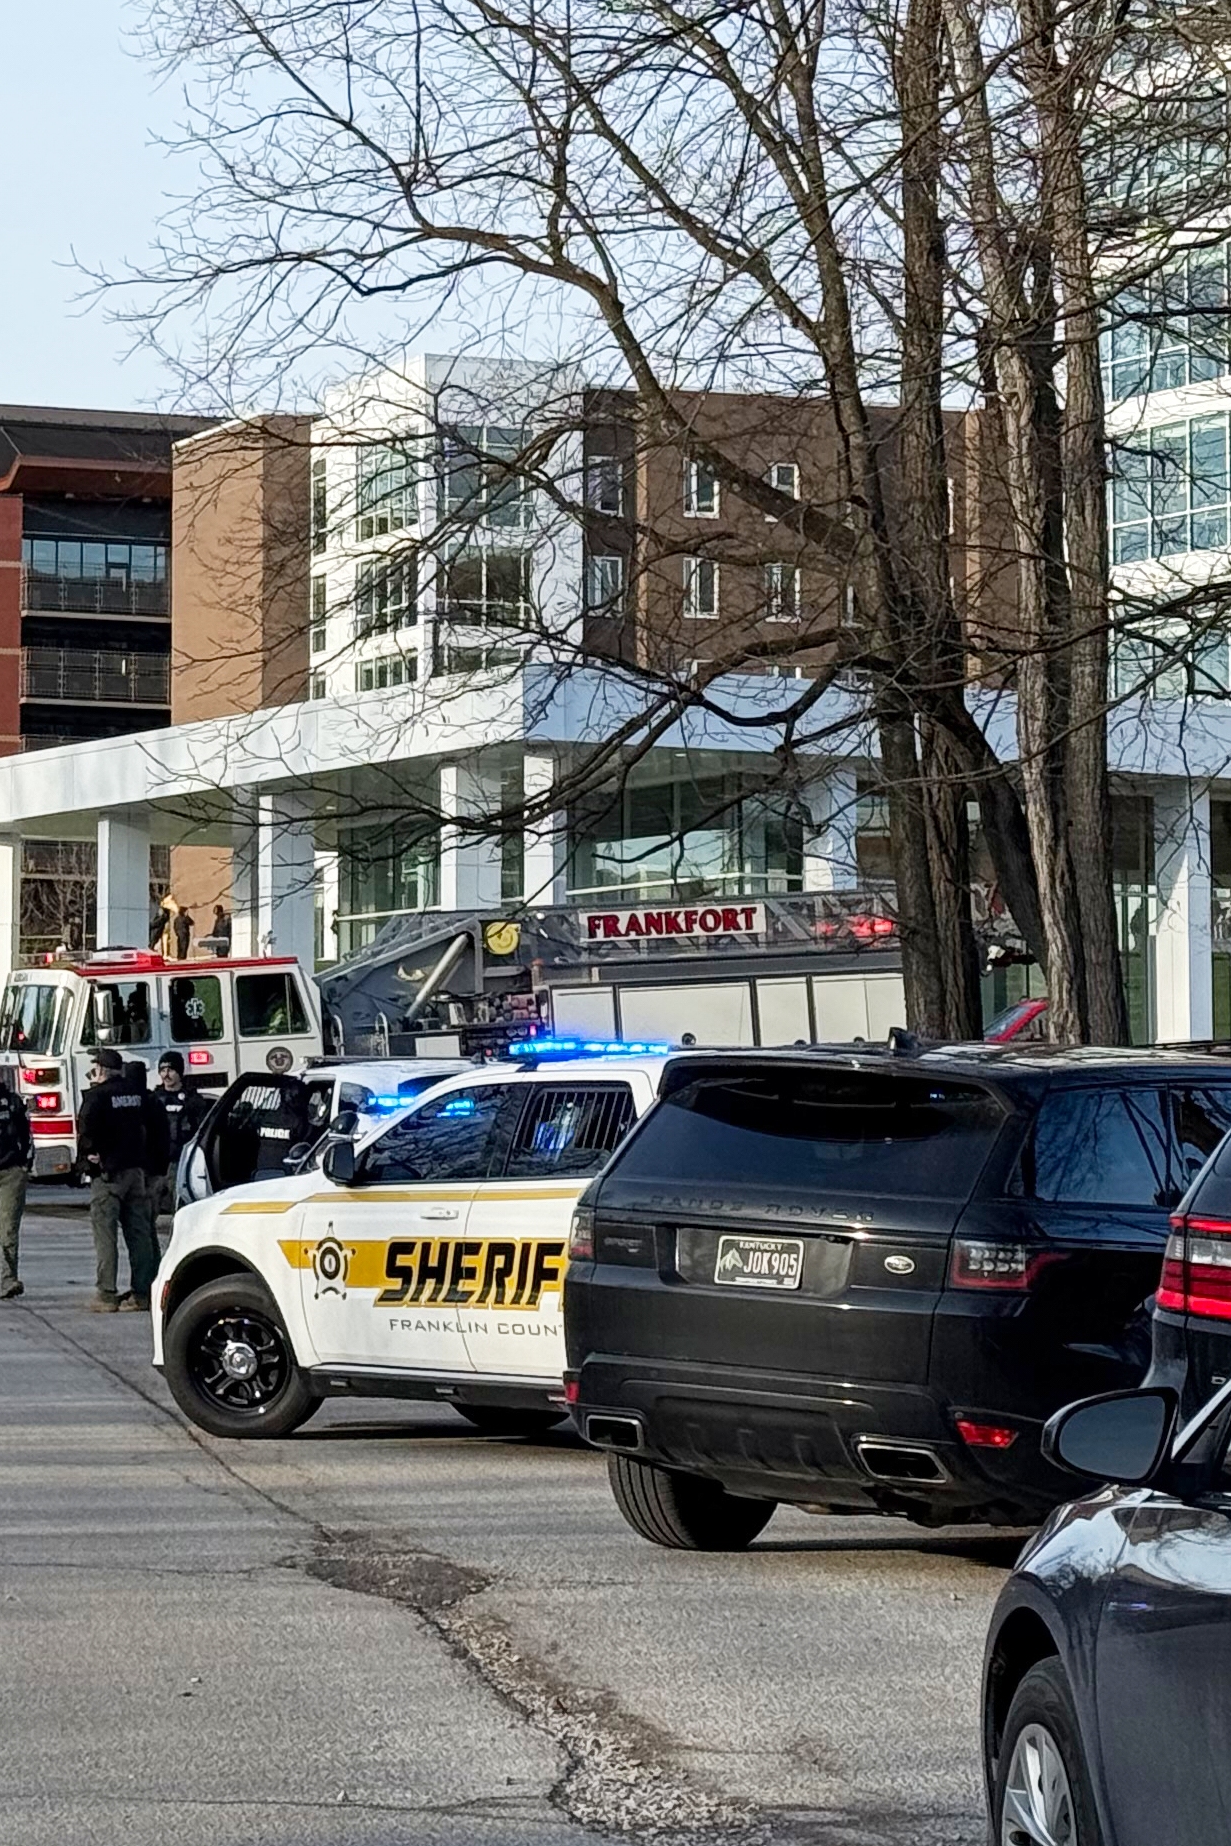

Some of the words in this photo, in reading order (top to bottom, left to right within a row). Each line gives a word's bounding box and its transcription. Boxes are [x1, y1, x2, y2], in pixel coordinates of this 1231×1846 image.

[586, 906, 758, 939] FRANKFORT
[259, 1126, 291, 1139] POLICE
[738, 1241, 783, 1251] KENTUCKY
[375, 1240, 567, 1308] SHERIF
[388, 1318, 488, 1335] FRANKLIN
[497, 1322, 563, 1337] COUN
